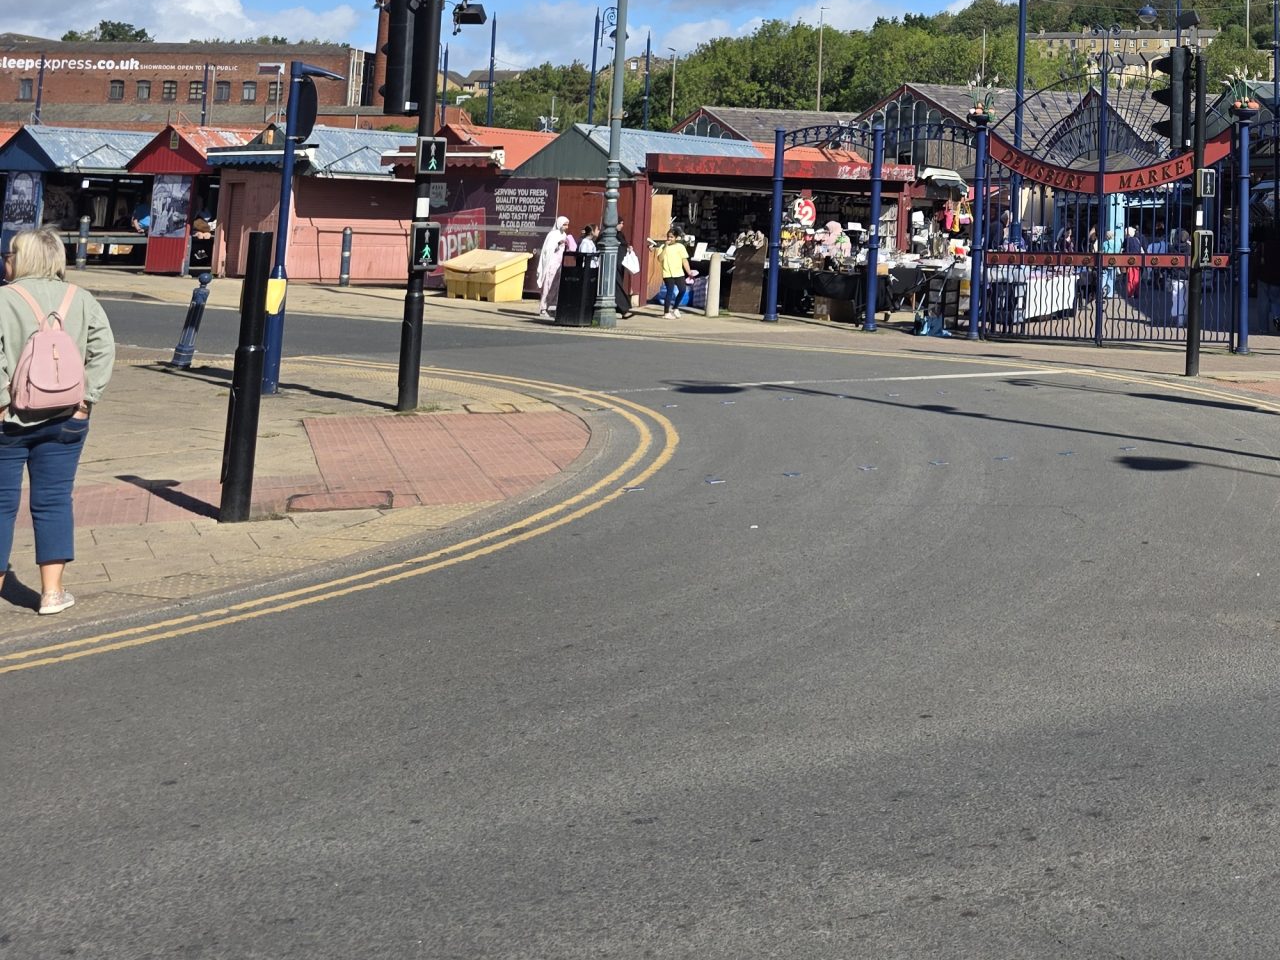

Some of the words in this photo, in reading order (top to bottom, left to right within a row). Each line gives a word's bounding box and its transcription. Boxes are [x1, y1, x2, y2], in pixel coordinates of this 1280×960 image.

[0, 56, 140, 71] leepexpress.co.uk
[1002, 148, 1087, 190] DEWSBURY
[494, 188, 517, 196] SERVING
[530, 189, 549, 198] FRESH,
[495, 196, 518, 204] QUALITY
[519, 197, 546, 205] PRODUCE,
[495, 204, 527, 212] HOUSEHOLD
[498, 212, 511, 220] AND
[511, 213, 529, 221] TASTY
[529, 213, 541, 221] HOT
